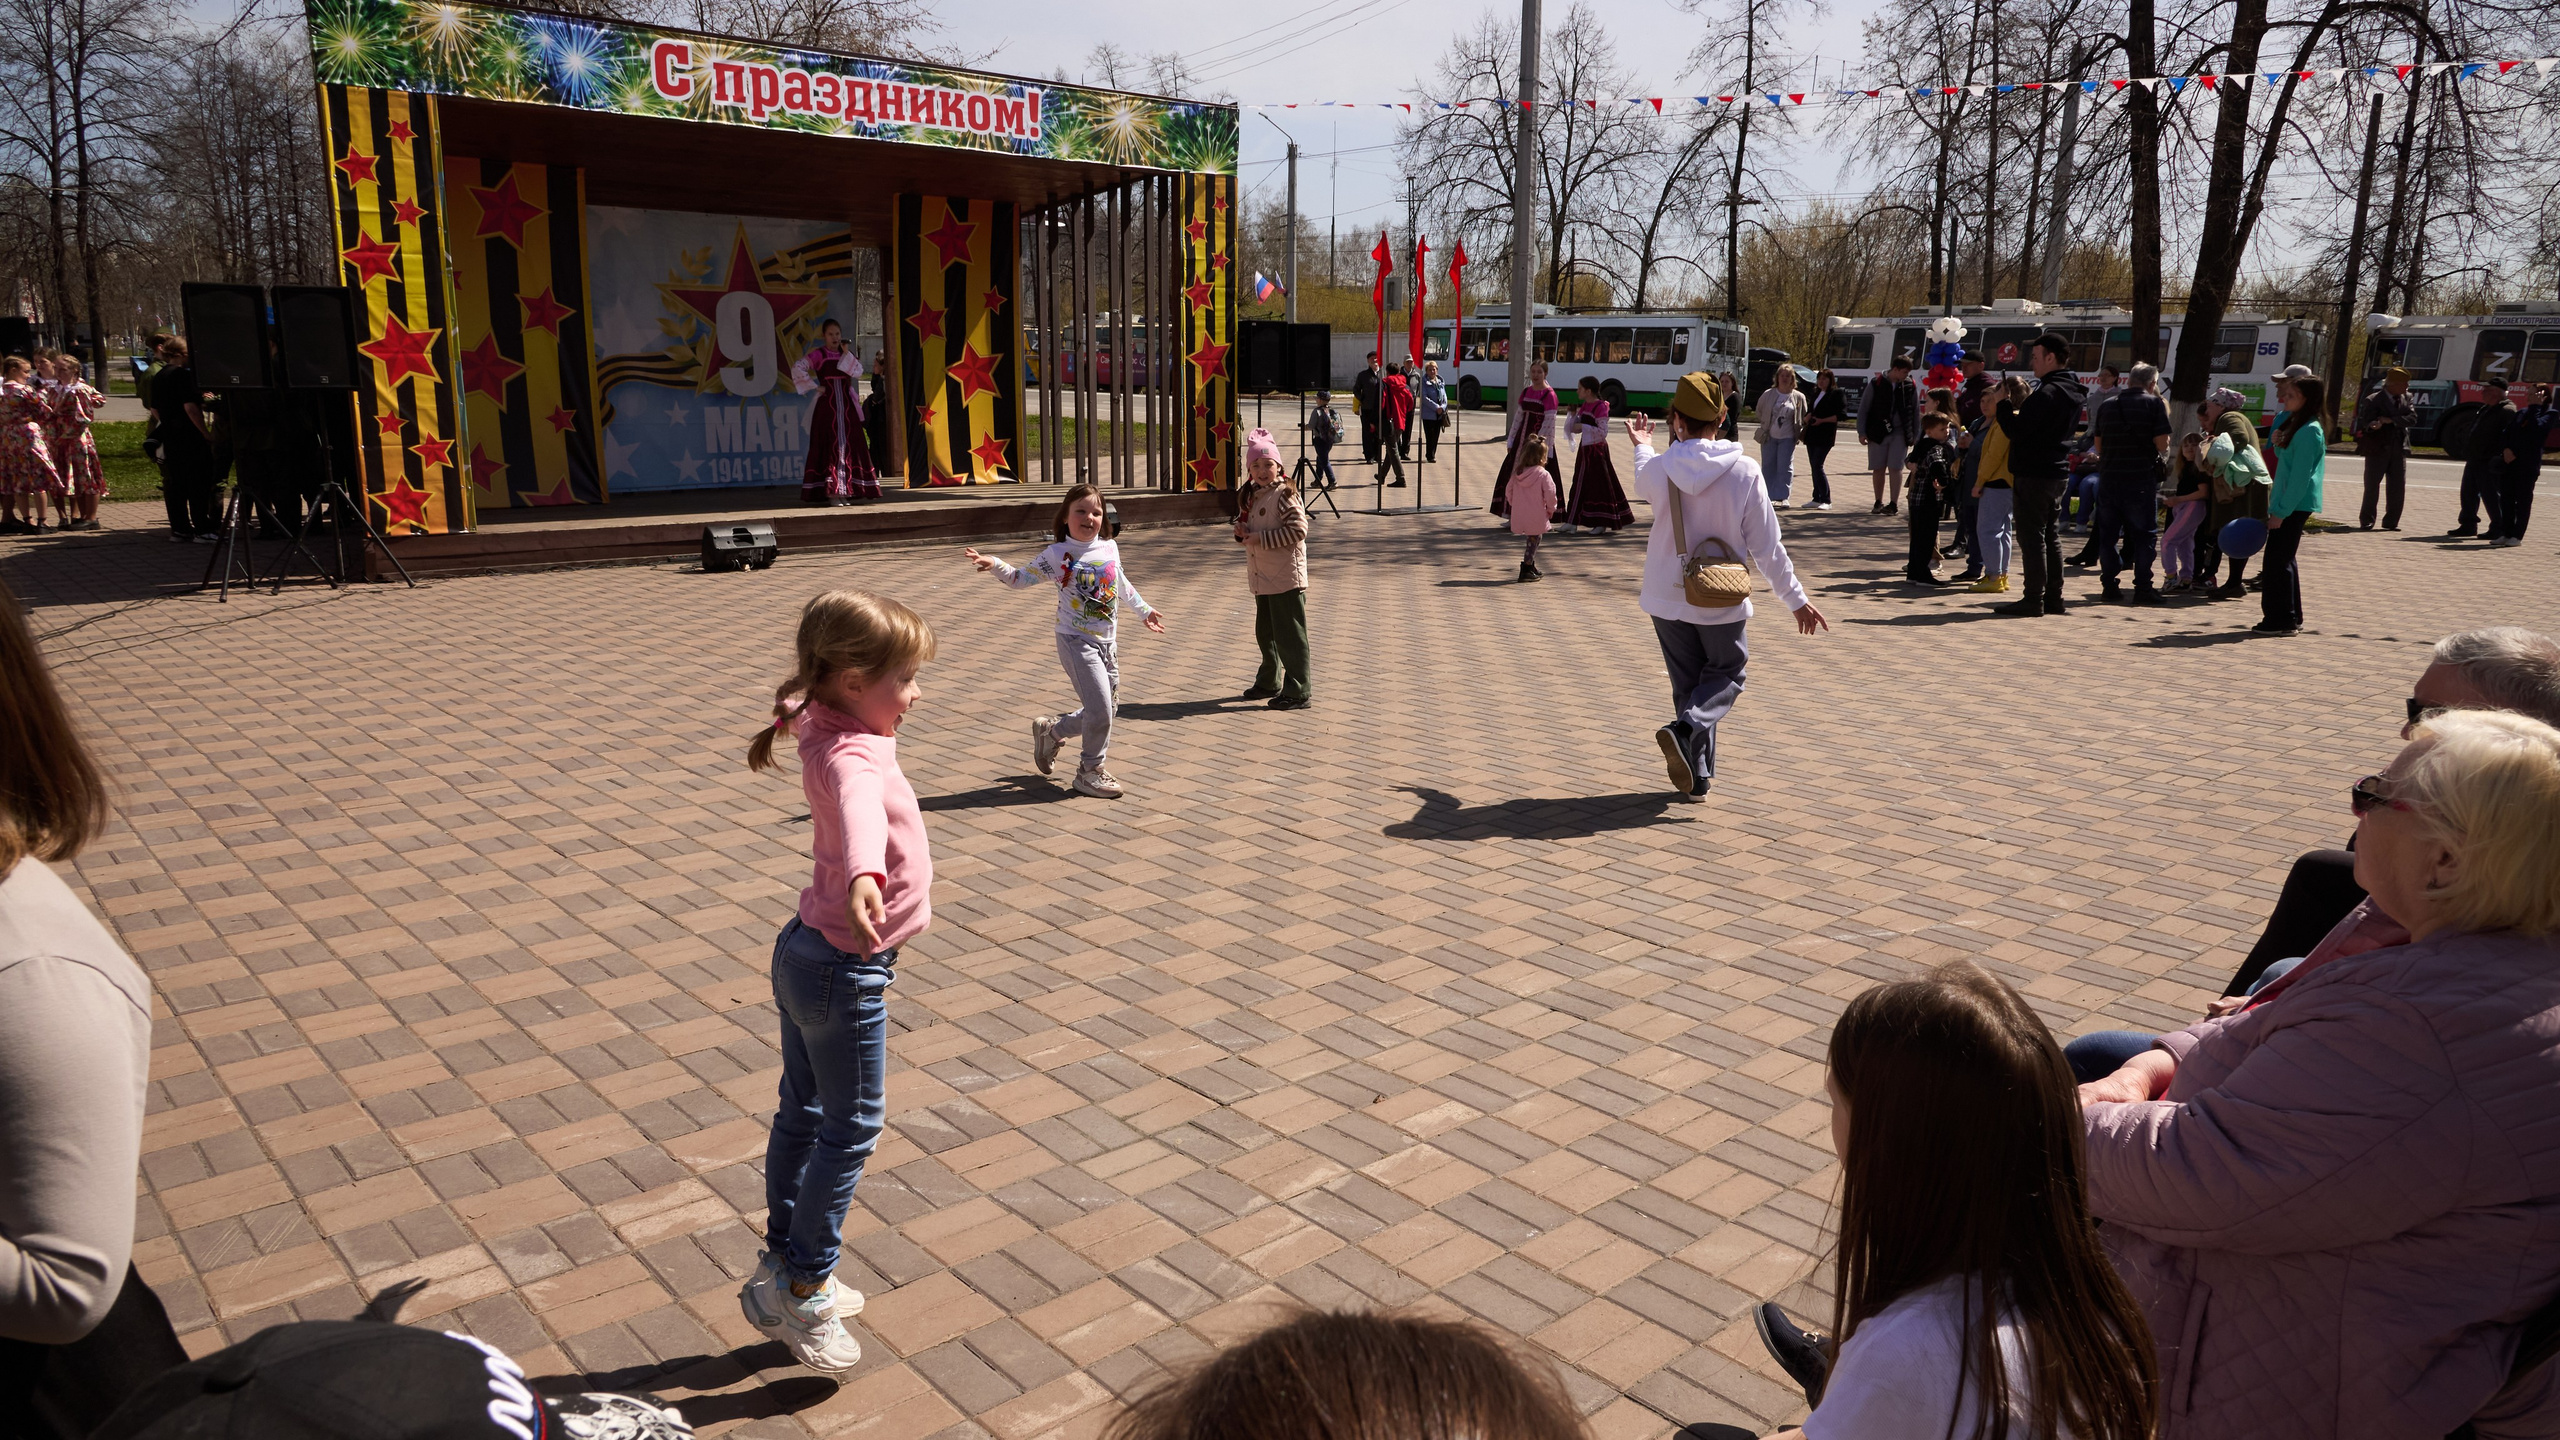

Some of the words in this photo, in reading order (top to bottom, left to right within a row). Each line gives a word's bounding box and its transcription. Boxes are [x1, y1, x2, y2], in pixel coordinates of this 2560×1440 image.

[653, 42, 694, 97] С
[712, 61, 1041, 139] праздником!
[716, 290, 778, 397] 9
[1674, 333, 1689, 345] 86
[1709, 336, 1719, 352] Z
[2257, 342, 2280, 356] 56
[1464, 346, 1476, 359] Z
[2485, 351, 2513, 373] Z
[703, 405, 799, 454] МАЯ
[708, 455, 804, 484] 1941-1945
